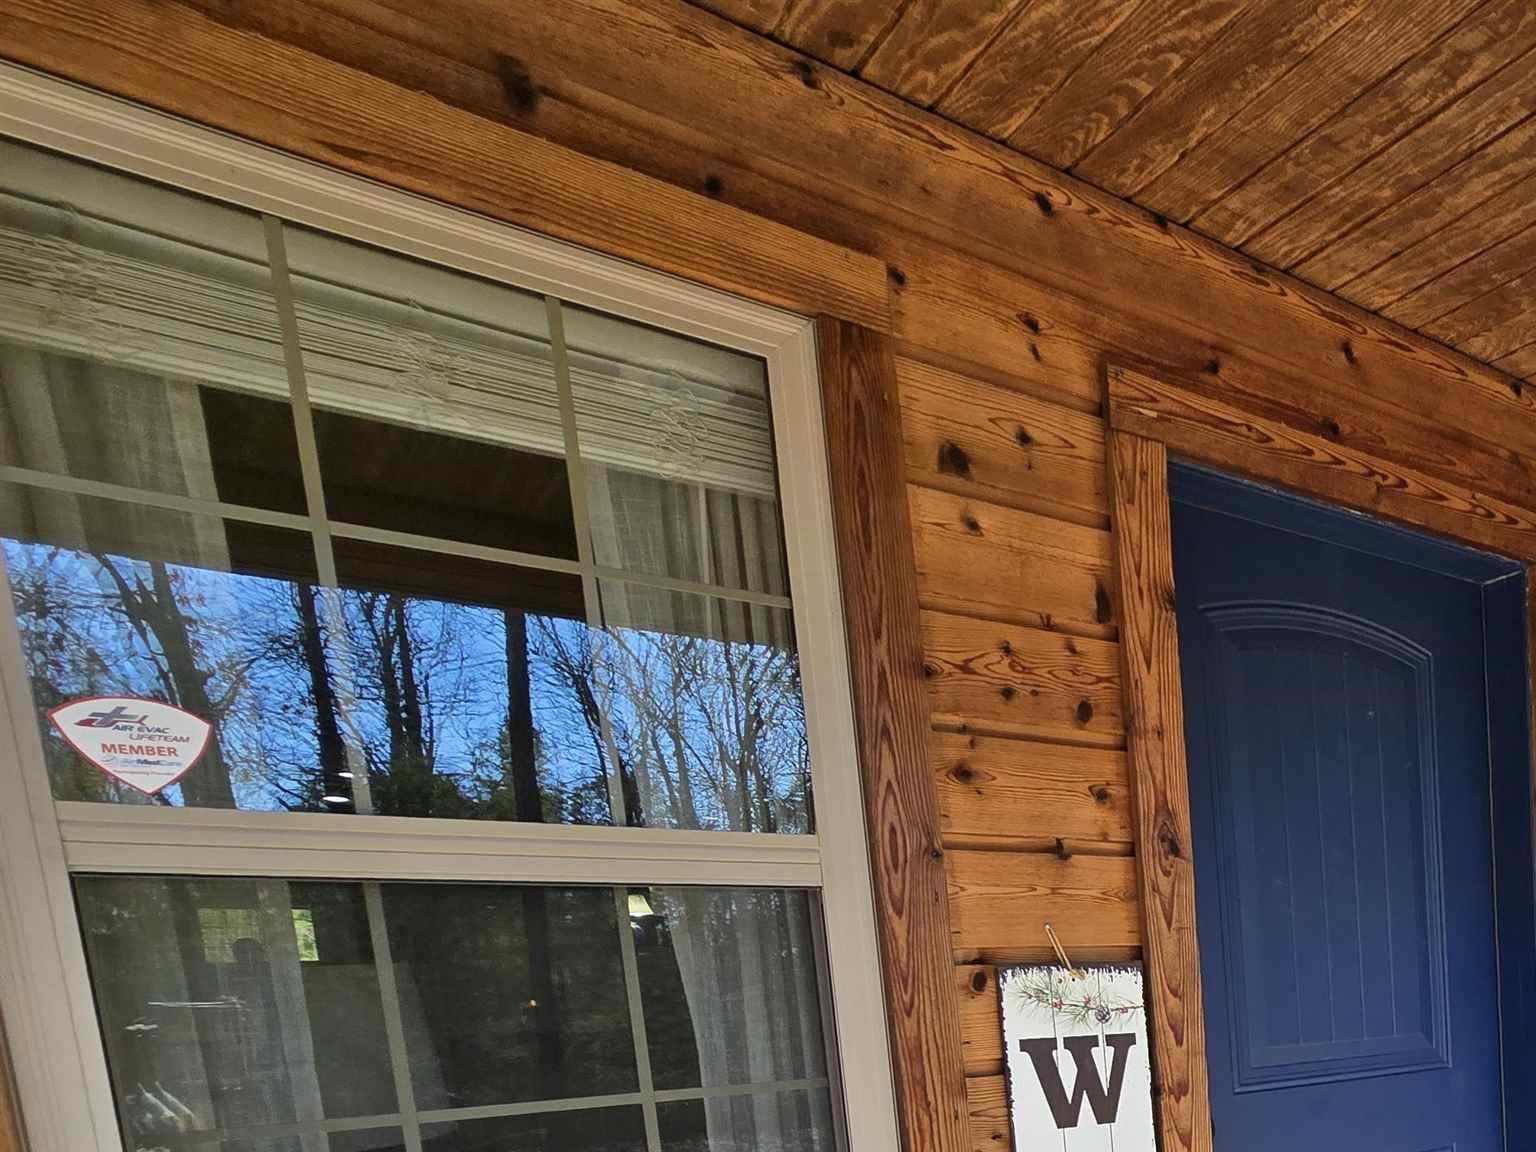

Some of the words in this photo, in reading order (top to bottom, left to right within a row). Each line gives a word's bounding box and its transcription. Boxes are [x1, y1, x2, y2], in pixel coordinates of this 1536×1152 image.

[137, 726, 171, 734] EVAC
[129, 733, 190, 743] LIFETEAM
[101, 743, 178, 757] MEMBER
